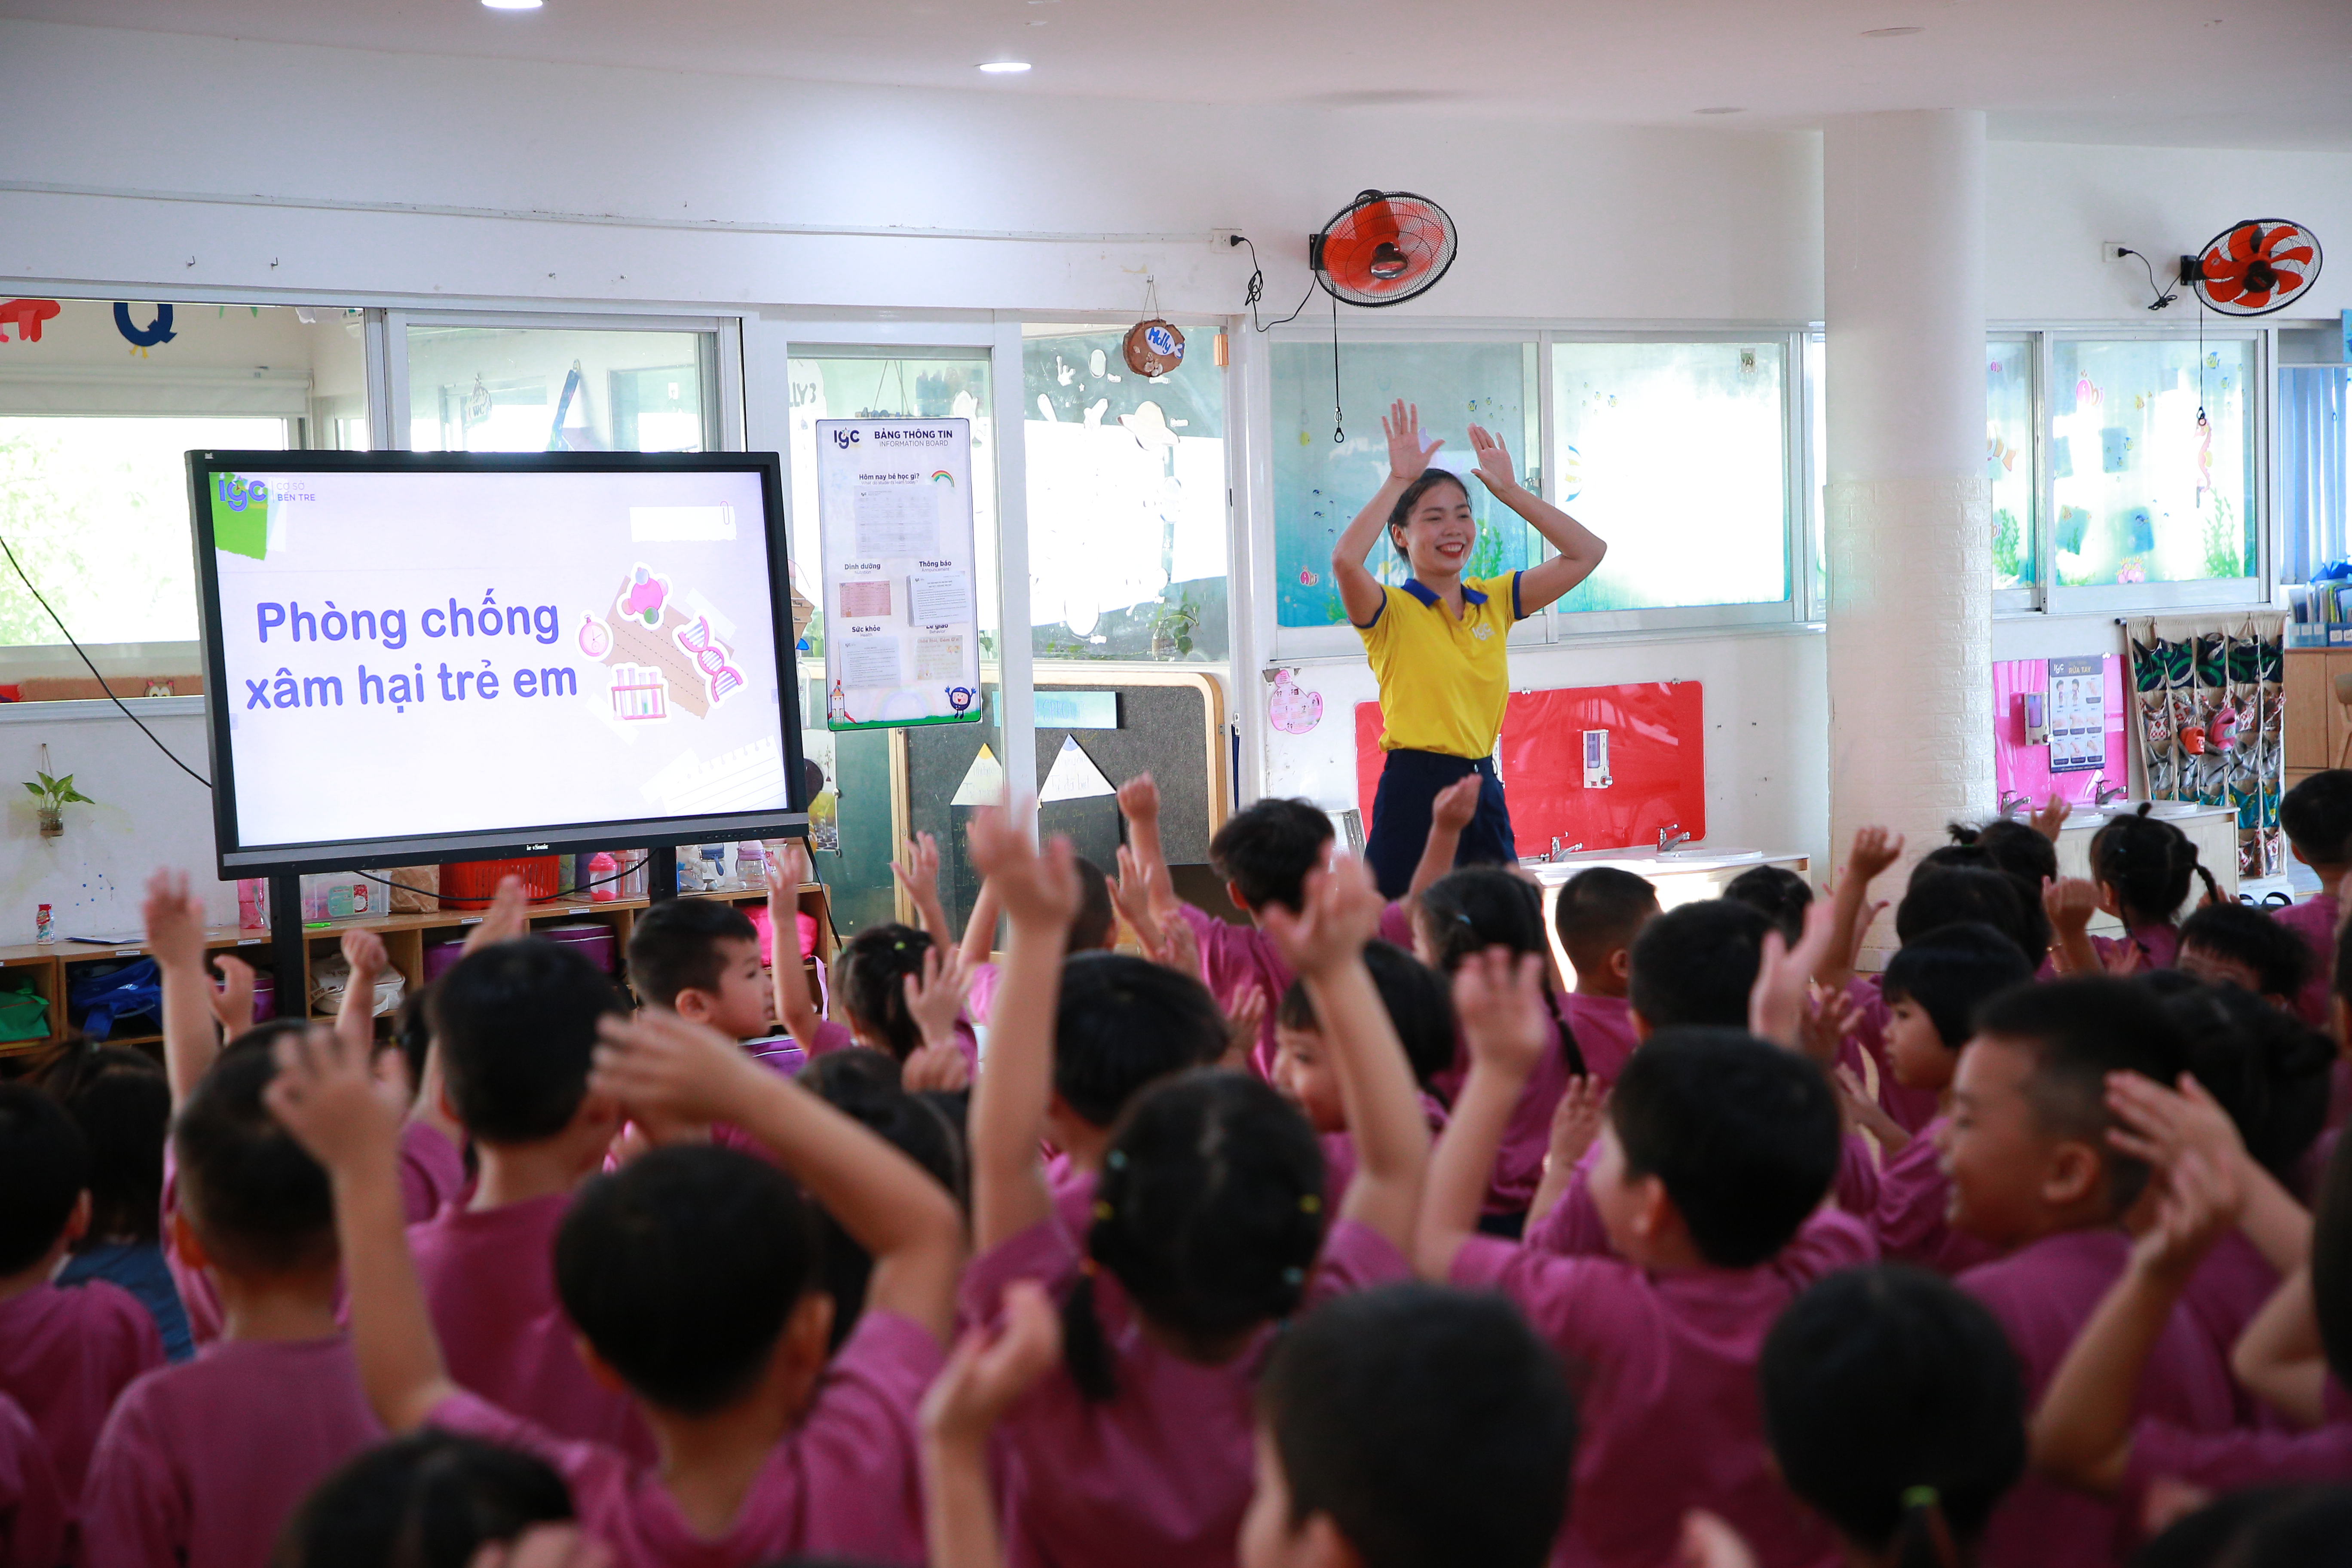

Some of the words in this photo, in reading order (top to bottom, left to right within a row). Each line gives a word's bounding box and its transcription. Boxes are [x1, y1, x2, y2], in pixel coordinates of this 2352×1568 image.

[1148, 327, 1171, 355] Molly
[874, 428, 901, 439] BẢNG
[903, 429, 935, 438] THÔNG
[278, 490, 296, 501] BẾN
[257, 600, 407, 649] Phòng
[421, 588, 559, 644] chống
[245, 667, 343, 710] xâm
[358, 662, 425, 714] hại
[437, 659, 499, 701] trẻ
[513, 666, 577, 698] em
